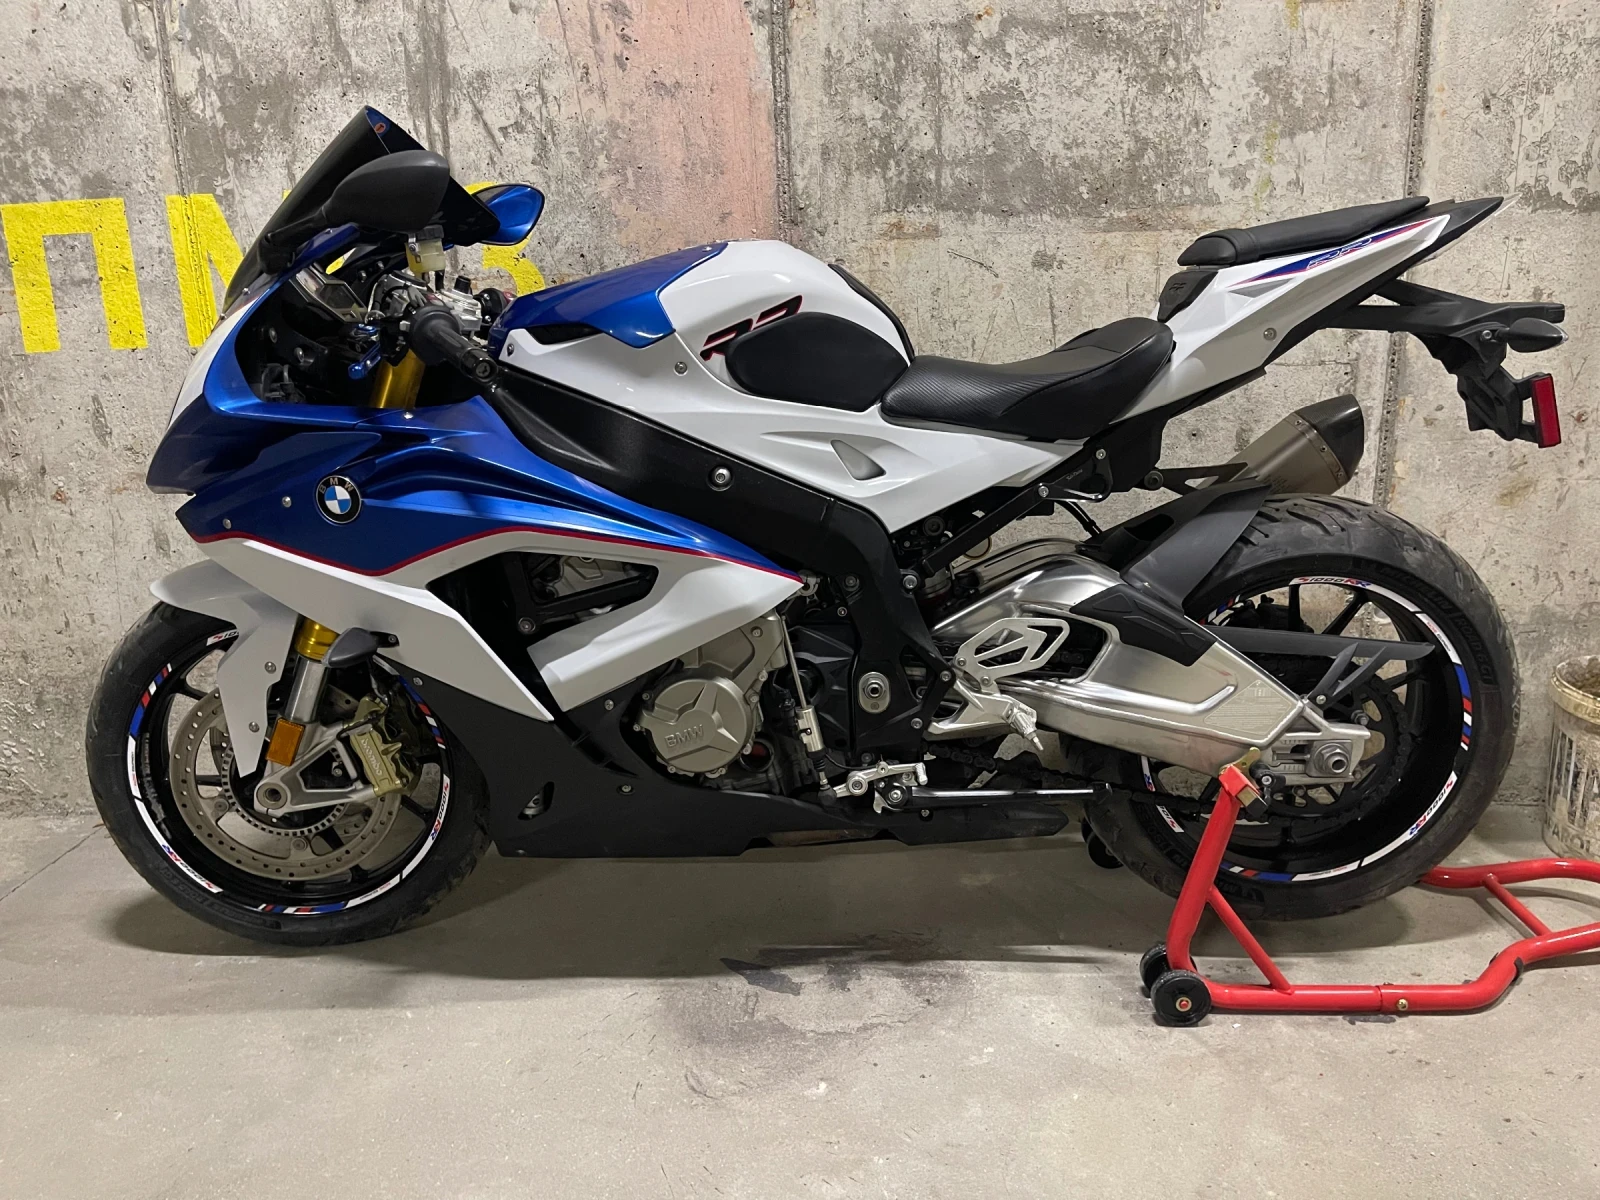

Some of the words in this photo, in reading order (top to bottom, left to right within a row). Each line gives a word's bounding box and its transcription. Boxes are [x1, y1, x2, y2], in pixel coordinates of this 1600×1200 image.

[318, 477, 355, 494] BMW
[664, 724, 704, 747] BMW
[361, 738, 383, 776] brembo
